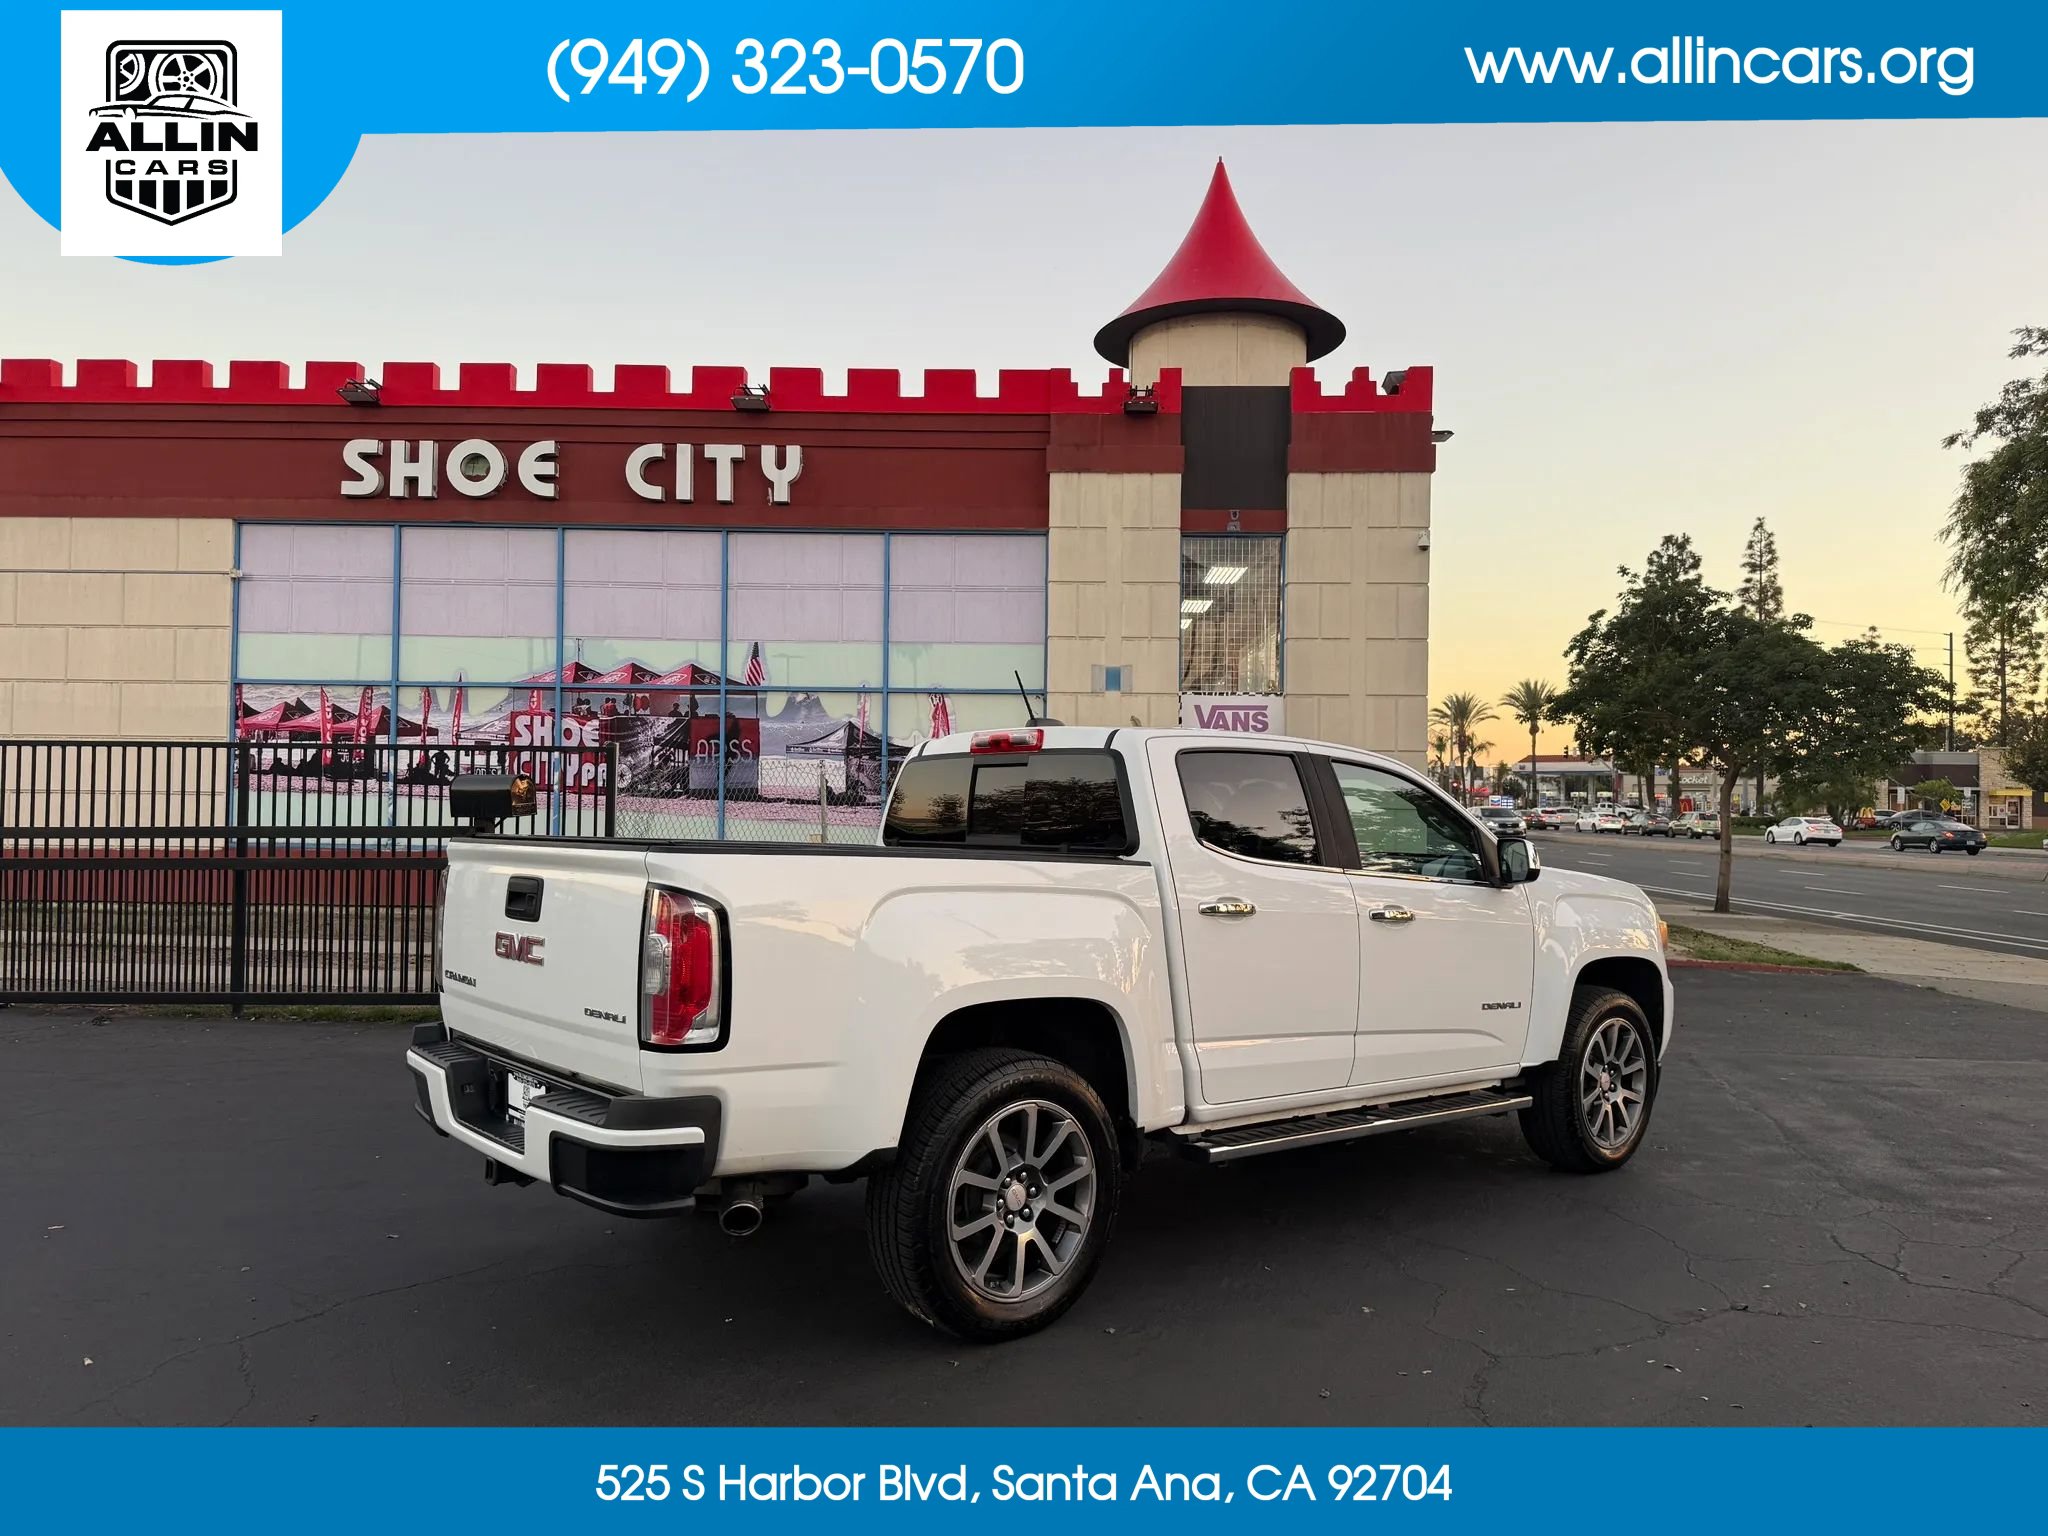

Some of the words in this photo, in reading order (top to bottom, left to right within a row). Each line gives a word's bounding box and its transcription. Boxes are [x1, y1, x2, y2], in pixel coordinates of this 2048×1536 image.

[340, 438, 559, 498] SHOE
[625, 443, 803, 503] CITY
[513, 714, 600, 748] SHOE
[1194, 704, 1270, 733] VANS
[1679, 775, 1709, 784] ocket
[495, 930, 546, 967] GMC
[584, 1007, 627, 1025] DENALI
[1481, 1001, 1522, 1011] DENALI
